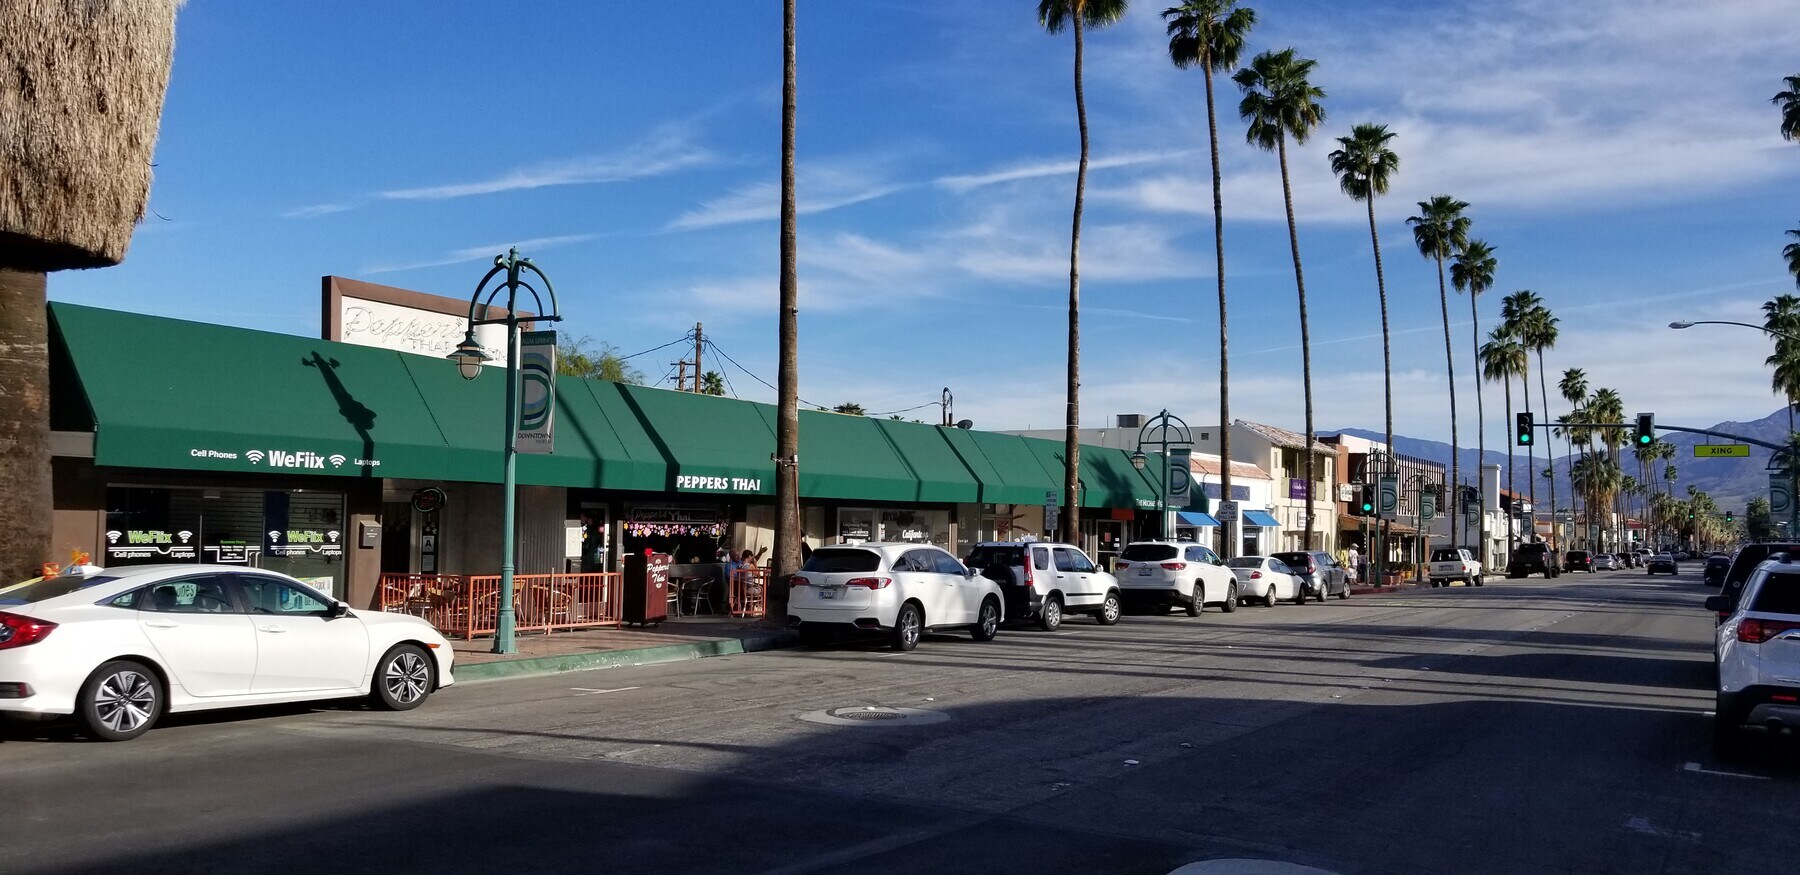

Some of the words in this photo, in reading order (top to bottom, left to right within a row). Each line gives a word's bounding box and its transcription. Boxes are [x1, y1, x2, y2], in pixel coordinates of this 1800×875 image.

[191, 449, 207, 457] Cell
[208, 450, 238, 459] Phones
[268, 450, 325, 469] WeFiix
[354, 458, 380, 467] Laptops
[676, 475, 728, 490] PEPPERS
[732, 477, 760, 491] THAI
